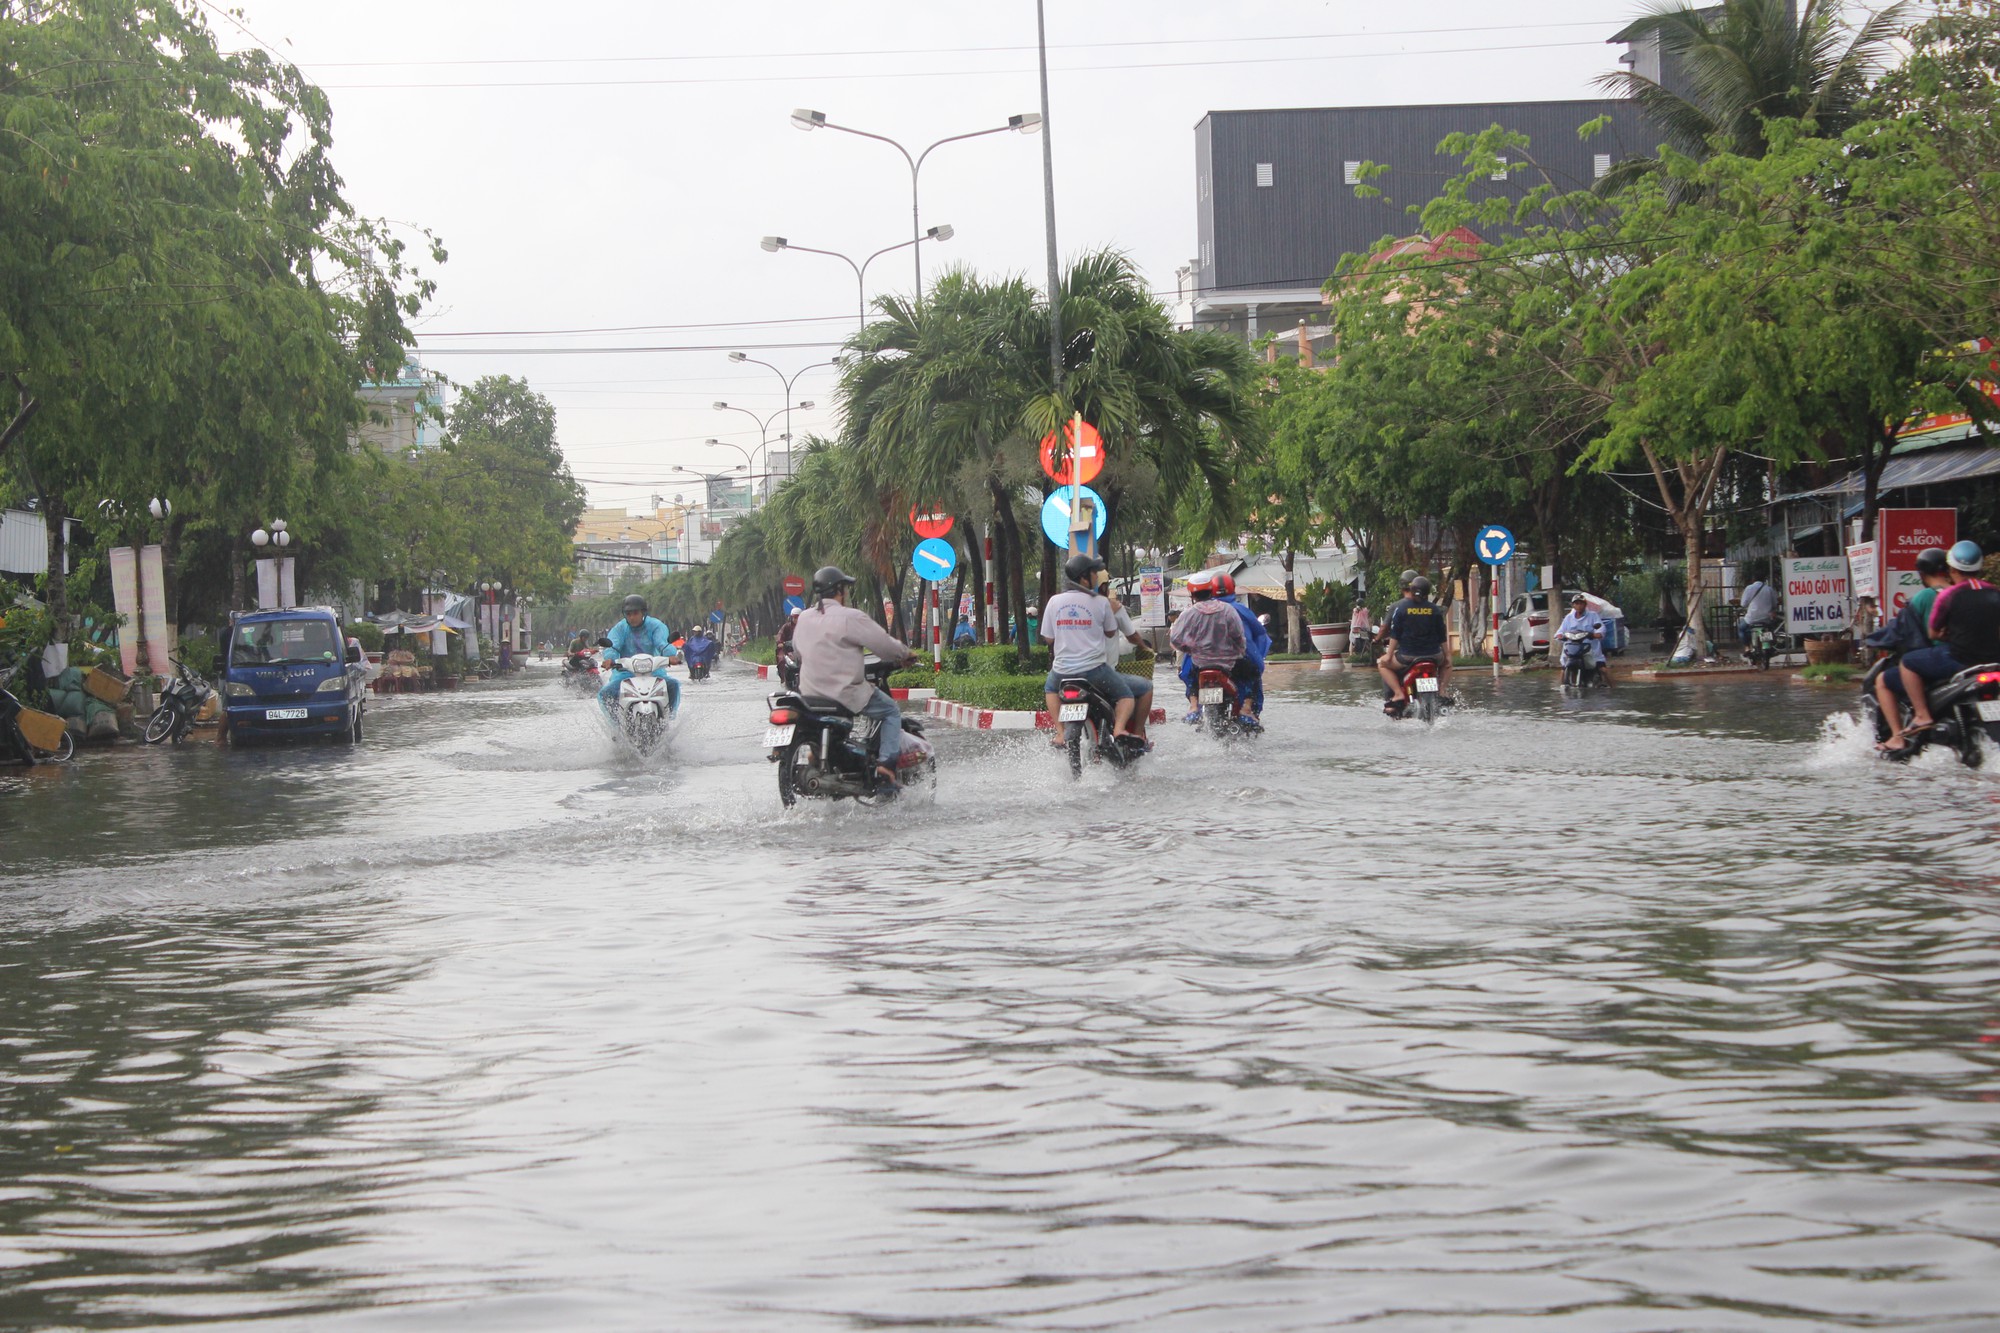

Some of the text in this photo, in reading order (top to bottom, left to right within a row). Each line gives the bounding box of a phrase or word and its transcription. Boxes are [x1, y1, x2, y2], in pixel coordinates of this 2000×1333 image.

[1898, 535, 1943, 545] SAIGON
[1793, 600, 1844, 621] MIẾN GÀ
[256, 668, 315, 679] VINAXUKI
